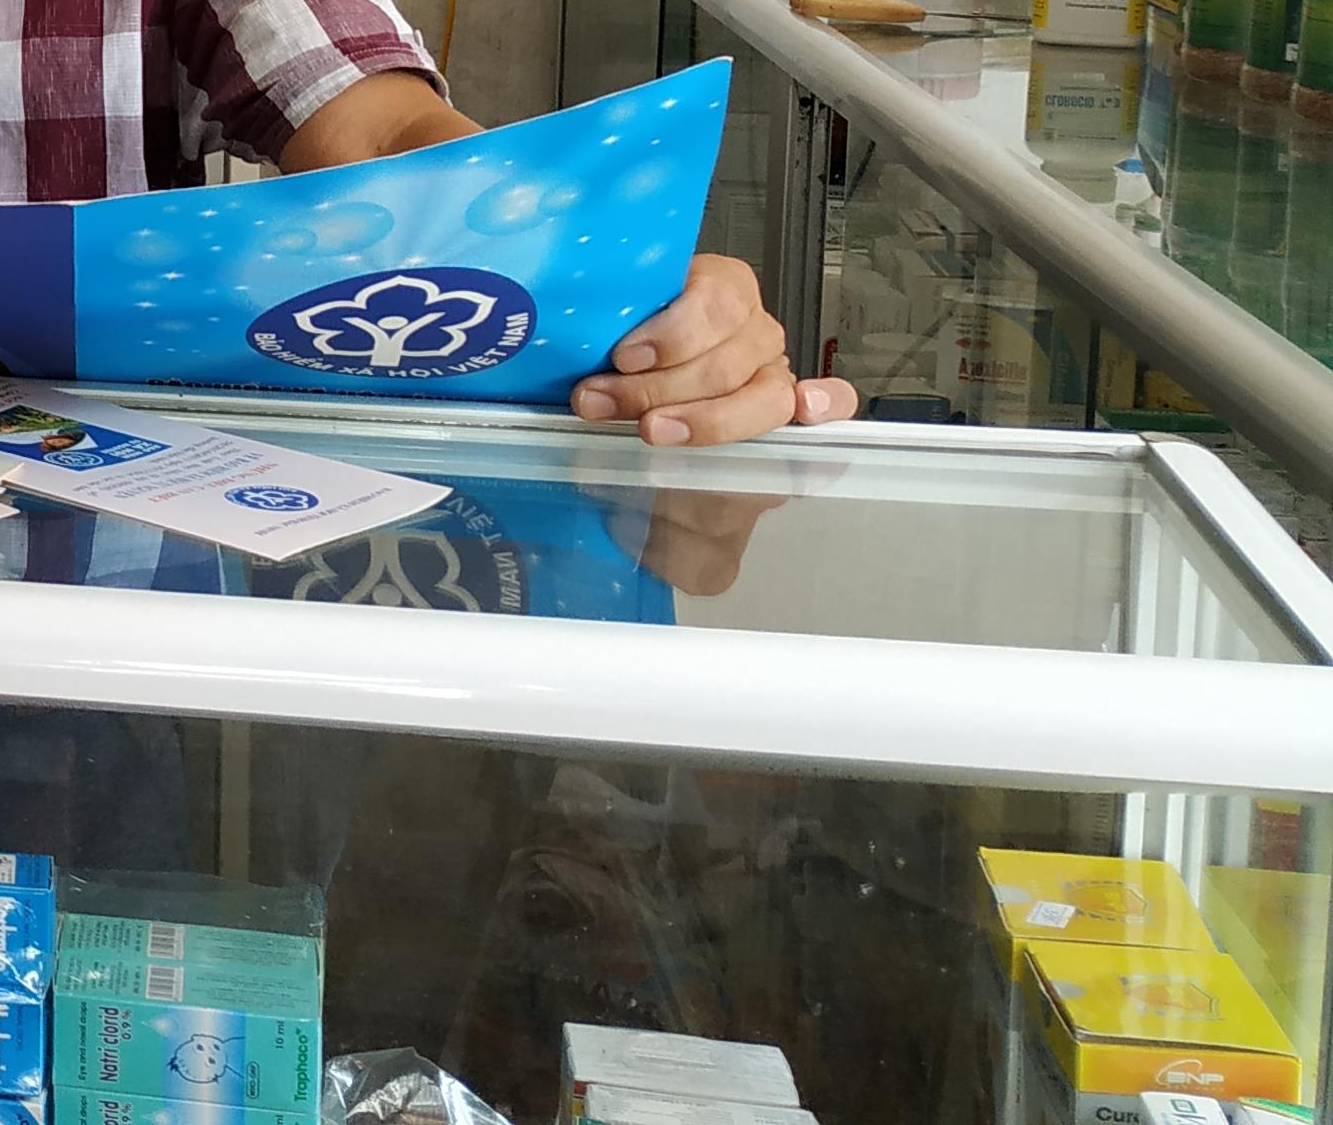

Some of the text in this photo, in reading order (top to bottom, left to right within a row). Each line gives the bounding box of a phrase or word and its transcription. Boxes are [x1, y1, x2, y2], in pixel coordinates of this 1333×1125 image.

[253, 331, 281, 353] BẢO
[278, 346, 334, 372] HIỂM
[388, 367, 443, 378] HỘI
[451, 347, 508, 375] VIỆT
[497, 311, 530, 347] NAM
[99, 1007, 119, 1083] Natri clorid
[275, 1037, 284, 1050] 10
[294, 1035, 310, 1102] Traphaco
[1167, 1072, 1225, 1085] BNP
